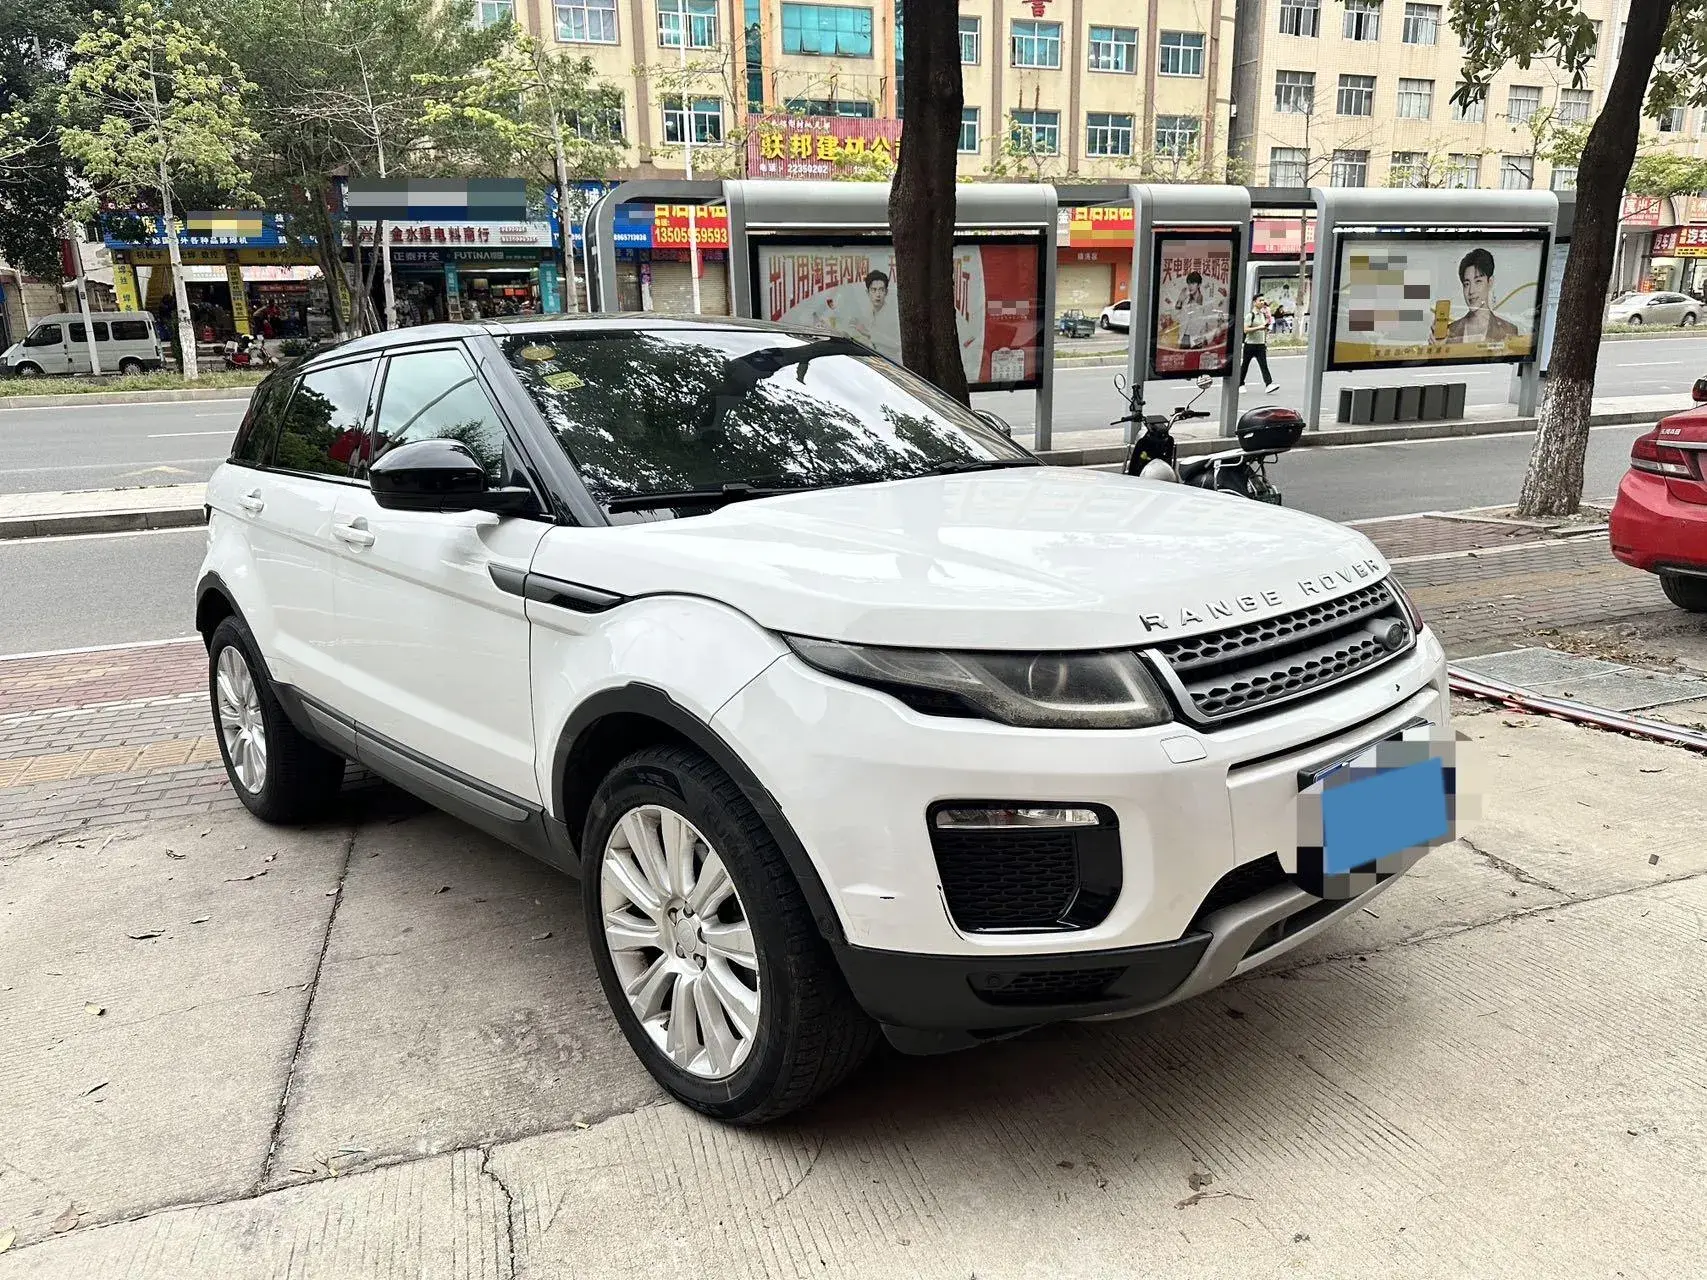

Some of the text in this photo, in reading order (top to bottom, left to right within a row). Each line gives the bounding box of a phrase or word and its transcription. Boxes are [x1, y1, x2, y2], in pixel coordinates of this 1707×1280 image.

[787, 164, 828, 174] 22350202
[393, 251, 439, 261] 正泰开关
[1163, 258, 1230, 285] 买电影票送奶茶
[769, 255, 869, 321] 出门用淘宝闪购
[1138, 558, 1380, 632] RANGE ROVER
